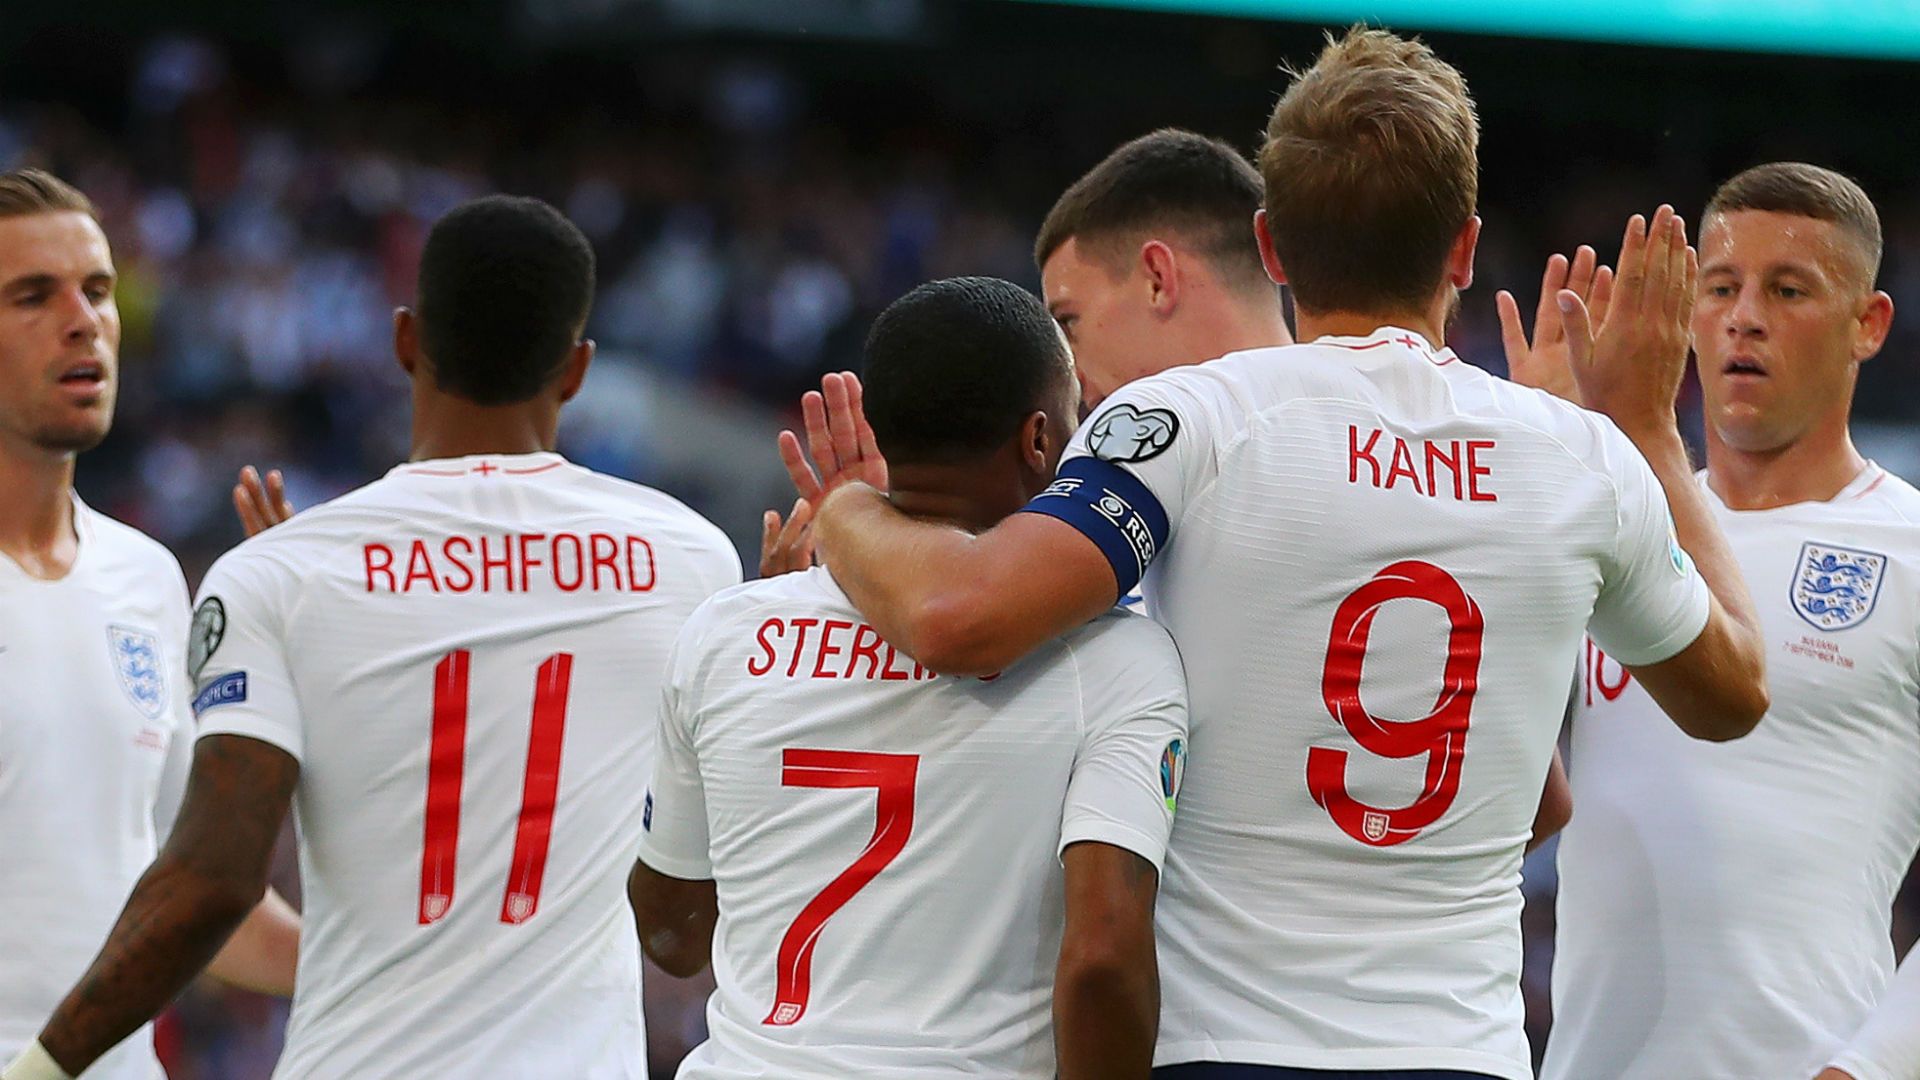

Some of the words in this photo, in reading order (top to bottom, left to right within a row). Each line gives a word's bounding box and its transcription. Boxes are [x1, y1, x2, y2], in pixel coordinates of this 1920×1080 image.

[1350, 425, 1498, 501] KANE
[363, 533, 657, 592] RASHFORD
[1126, 516, 1152, 566] RES
[748, 617, 1001, 681] STERL
[1307, 561, 1484, 847] 9
[418, 649, 574, 925] 11
[764, 749, 920, 1026] 7
